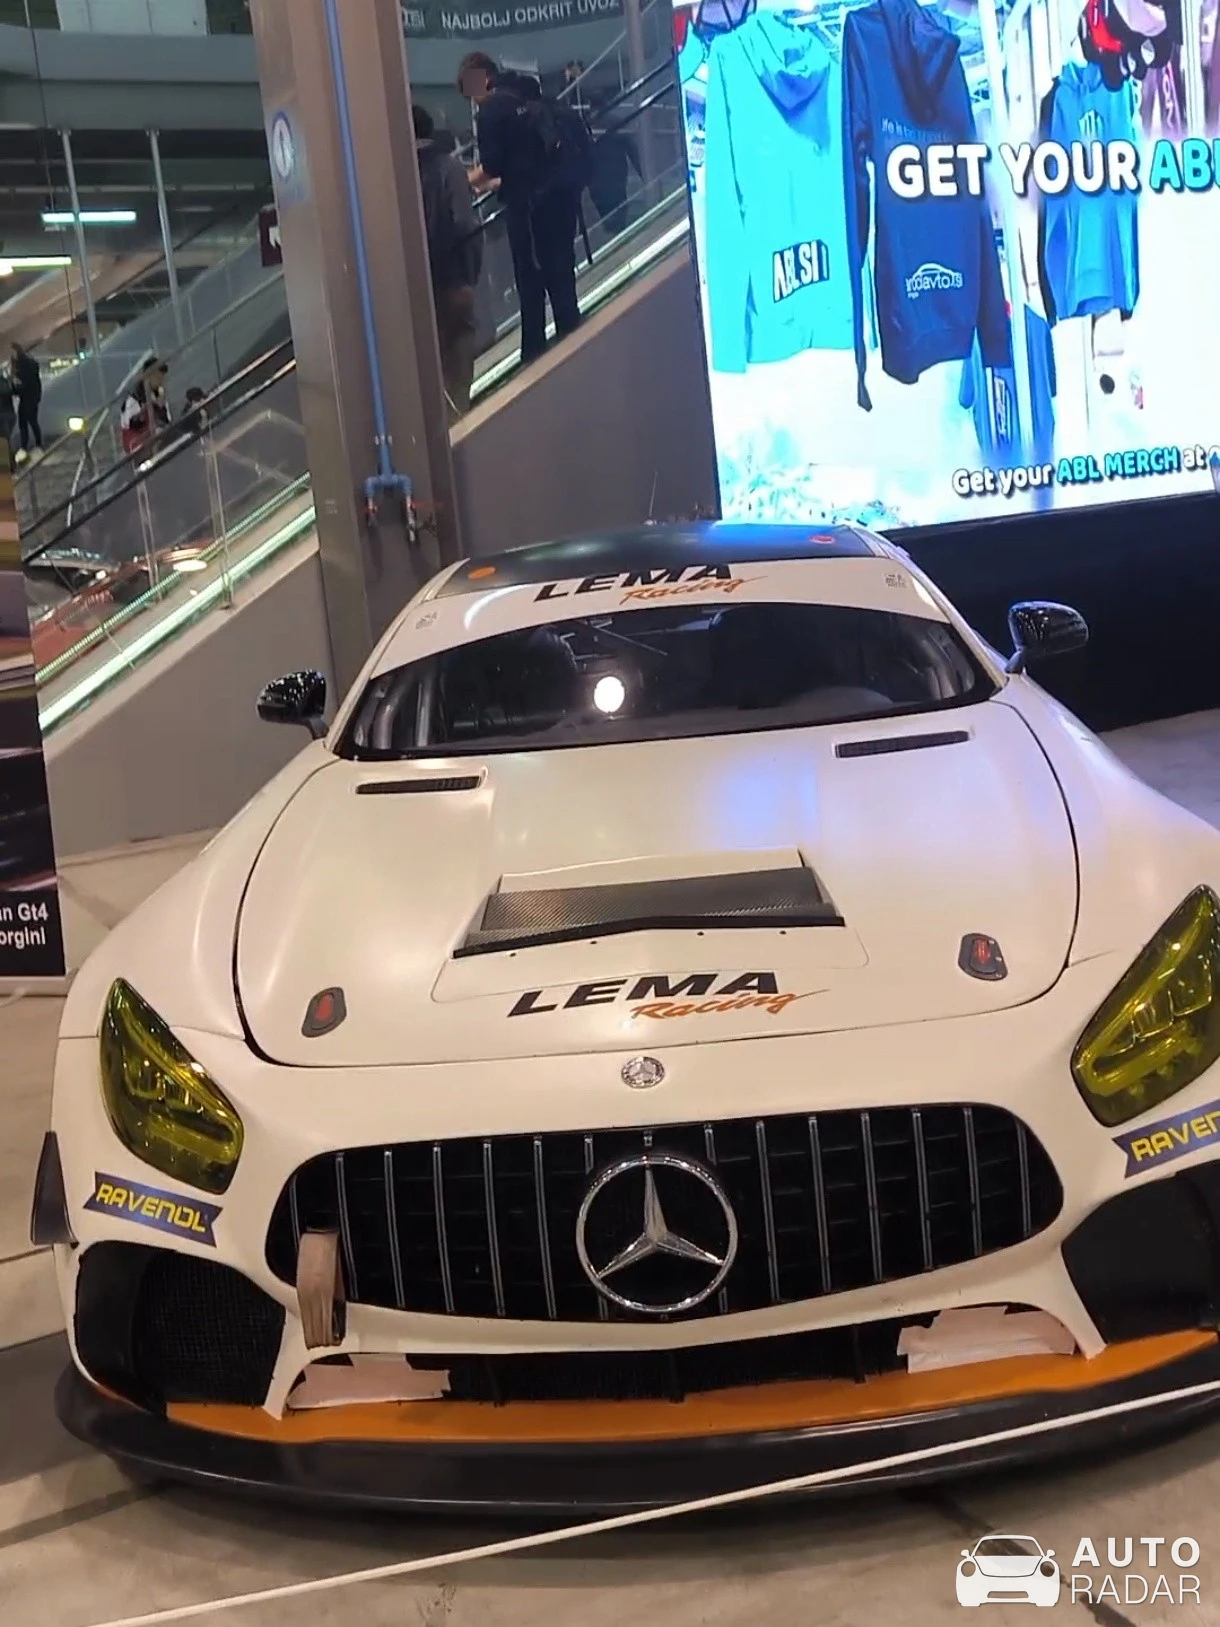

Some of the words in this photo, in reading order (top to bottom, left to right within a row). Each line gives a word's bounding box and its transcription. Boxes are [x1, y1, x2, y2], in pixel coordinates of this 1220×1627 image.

[441, 8, 511, 30] NAJBOLJ
[514, 1, 572, 24] ODKRIT
[886, 143, 988, 198] GET
[999, 139, 1139, 195] YOUR
[1150, 138, 1220, 192] AB
[952, 468, 997, 495] Get
[999, 464, 1053, 495] your
[1057, 455, 1101, 484] ABL
[1104, 447, 1179, 476] MERCH
[1182, 445, 1207, 469] at
[533, 563, 732, 602] LEMA
[620, 577, 760, 605] Racing
[0, 906, 13, 921] n
[18, 902, 49, 921] Gt4
[507, 971, 779, 1018] LEMA
[630, 990, 806, 1019] Racing
[96, 1182, 206, 1233] RAVENOL
